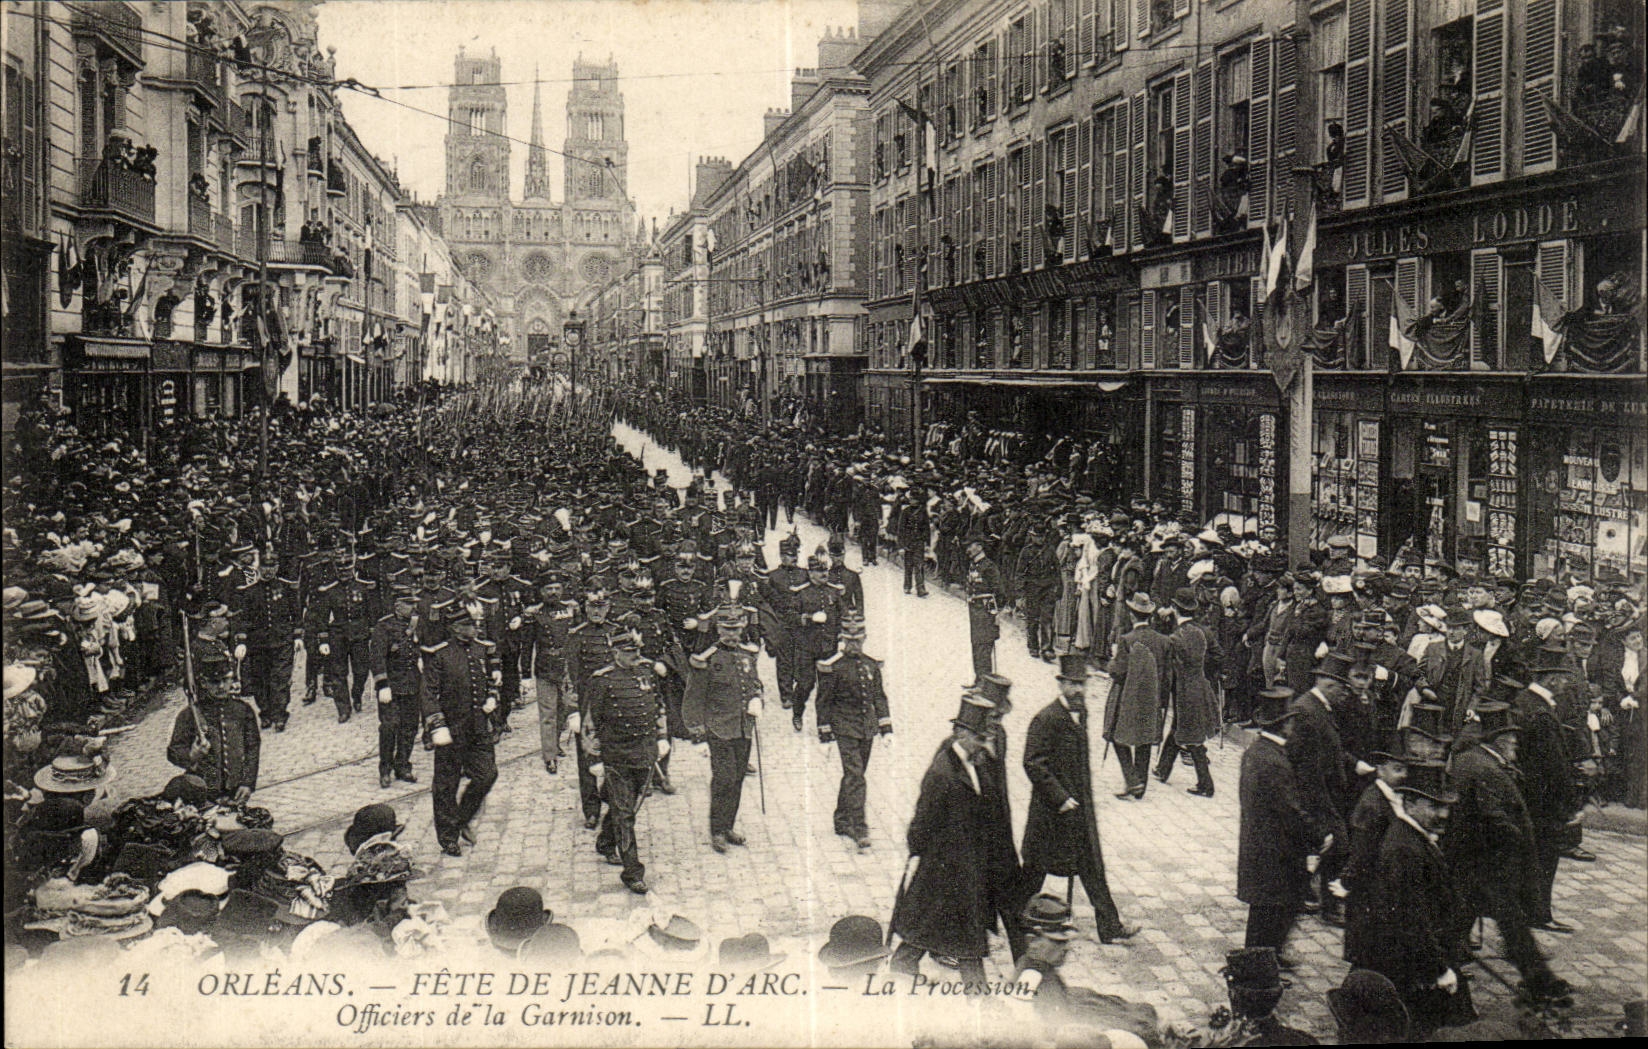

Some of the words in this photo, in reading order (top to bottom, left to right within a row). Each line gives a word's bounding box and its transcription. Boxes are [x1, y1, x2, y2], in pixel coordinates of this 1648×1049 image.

[1347, 225, 1430, 259] JULES
[1215, 251, 1257, 276] LIBR
[1530, 397, 1595, 412] PAPETERIE
[1562, 454, 1601, 468] NOUVEAU
[1571, 479, 1618, 495] LAROUSSE
